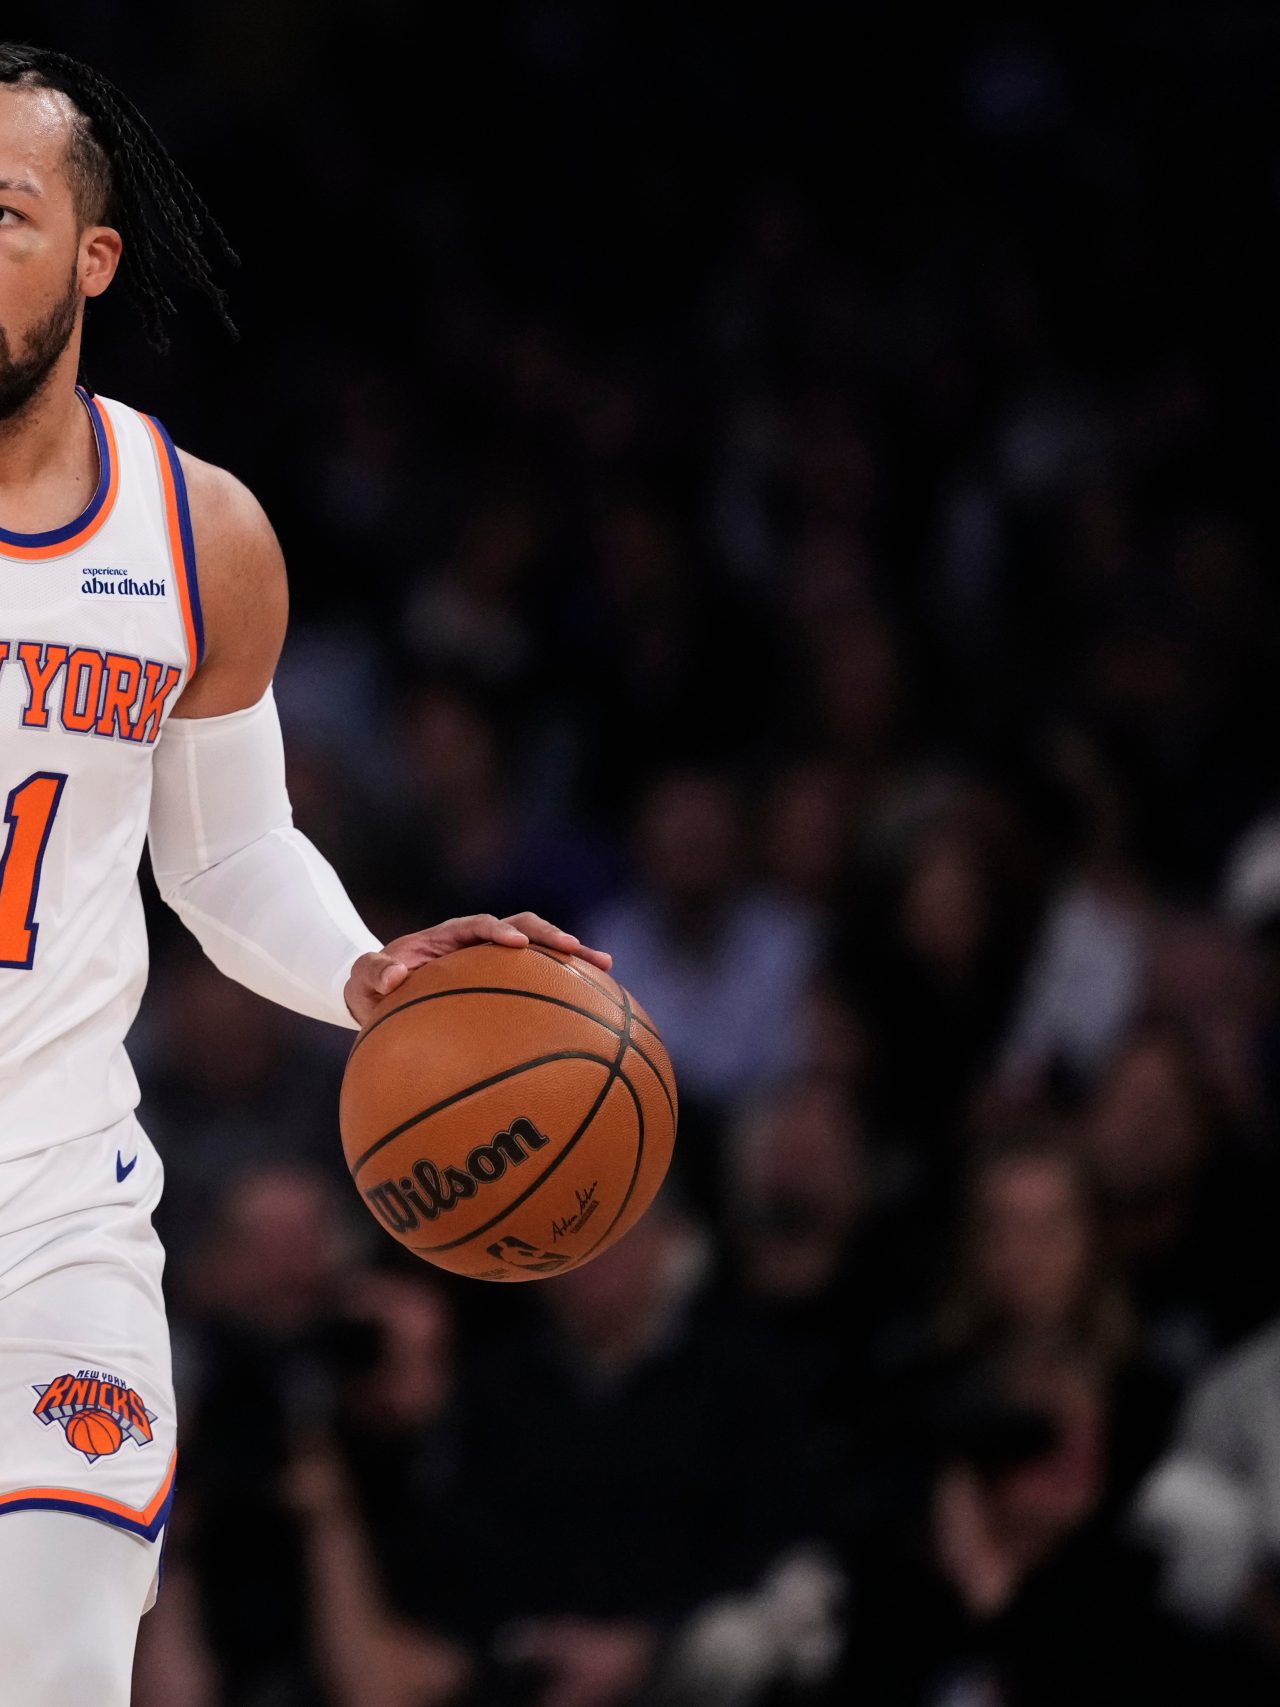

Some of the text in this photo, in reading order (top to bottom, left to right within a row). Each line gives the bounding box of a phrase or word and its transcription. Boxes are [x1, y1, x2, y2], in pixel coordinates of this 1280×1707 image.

[81, 577, 115, 594] abu
[82, 567, 128, 576] experience
[16, 640, 182, 746] YORK
[366, 1116, 550, 1234] Wilson
[76, 1369, 127, 1389] NEW YORK
[33, 1373, 153, 1441] KNICKS
